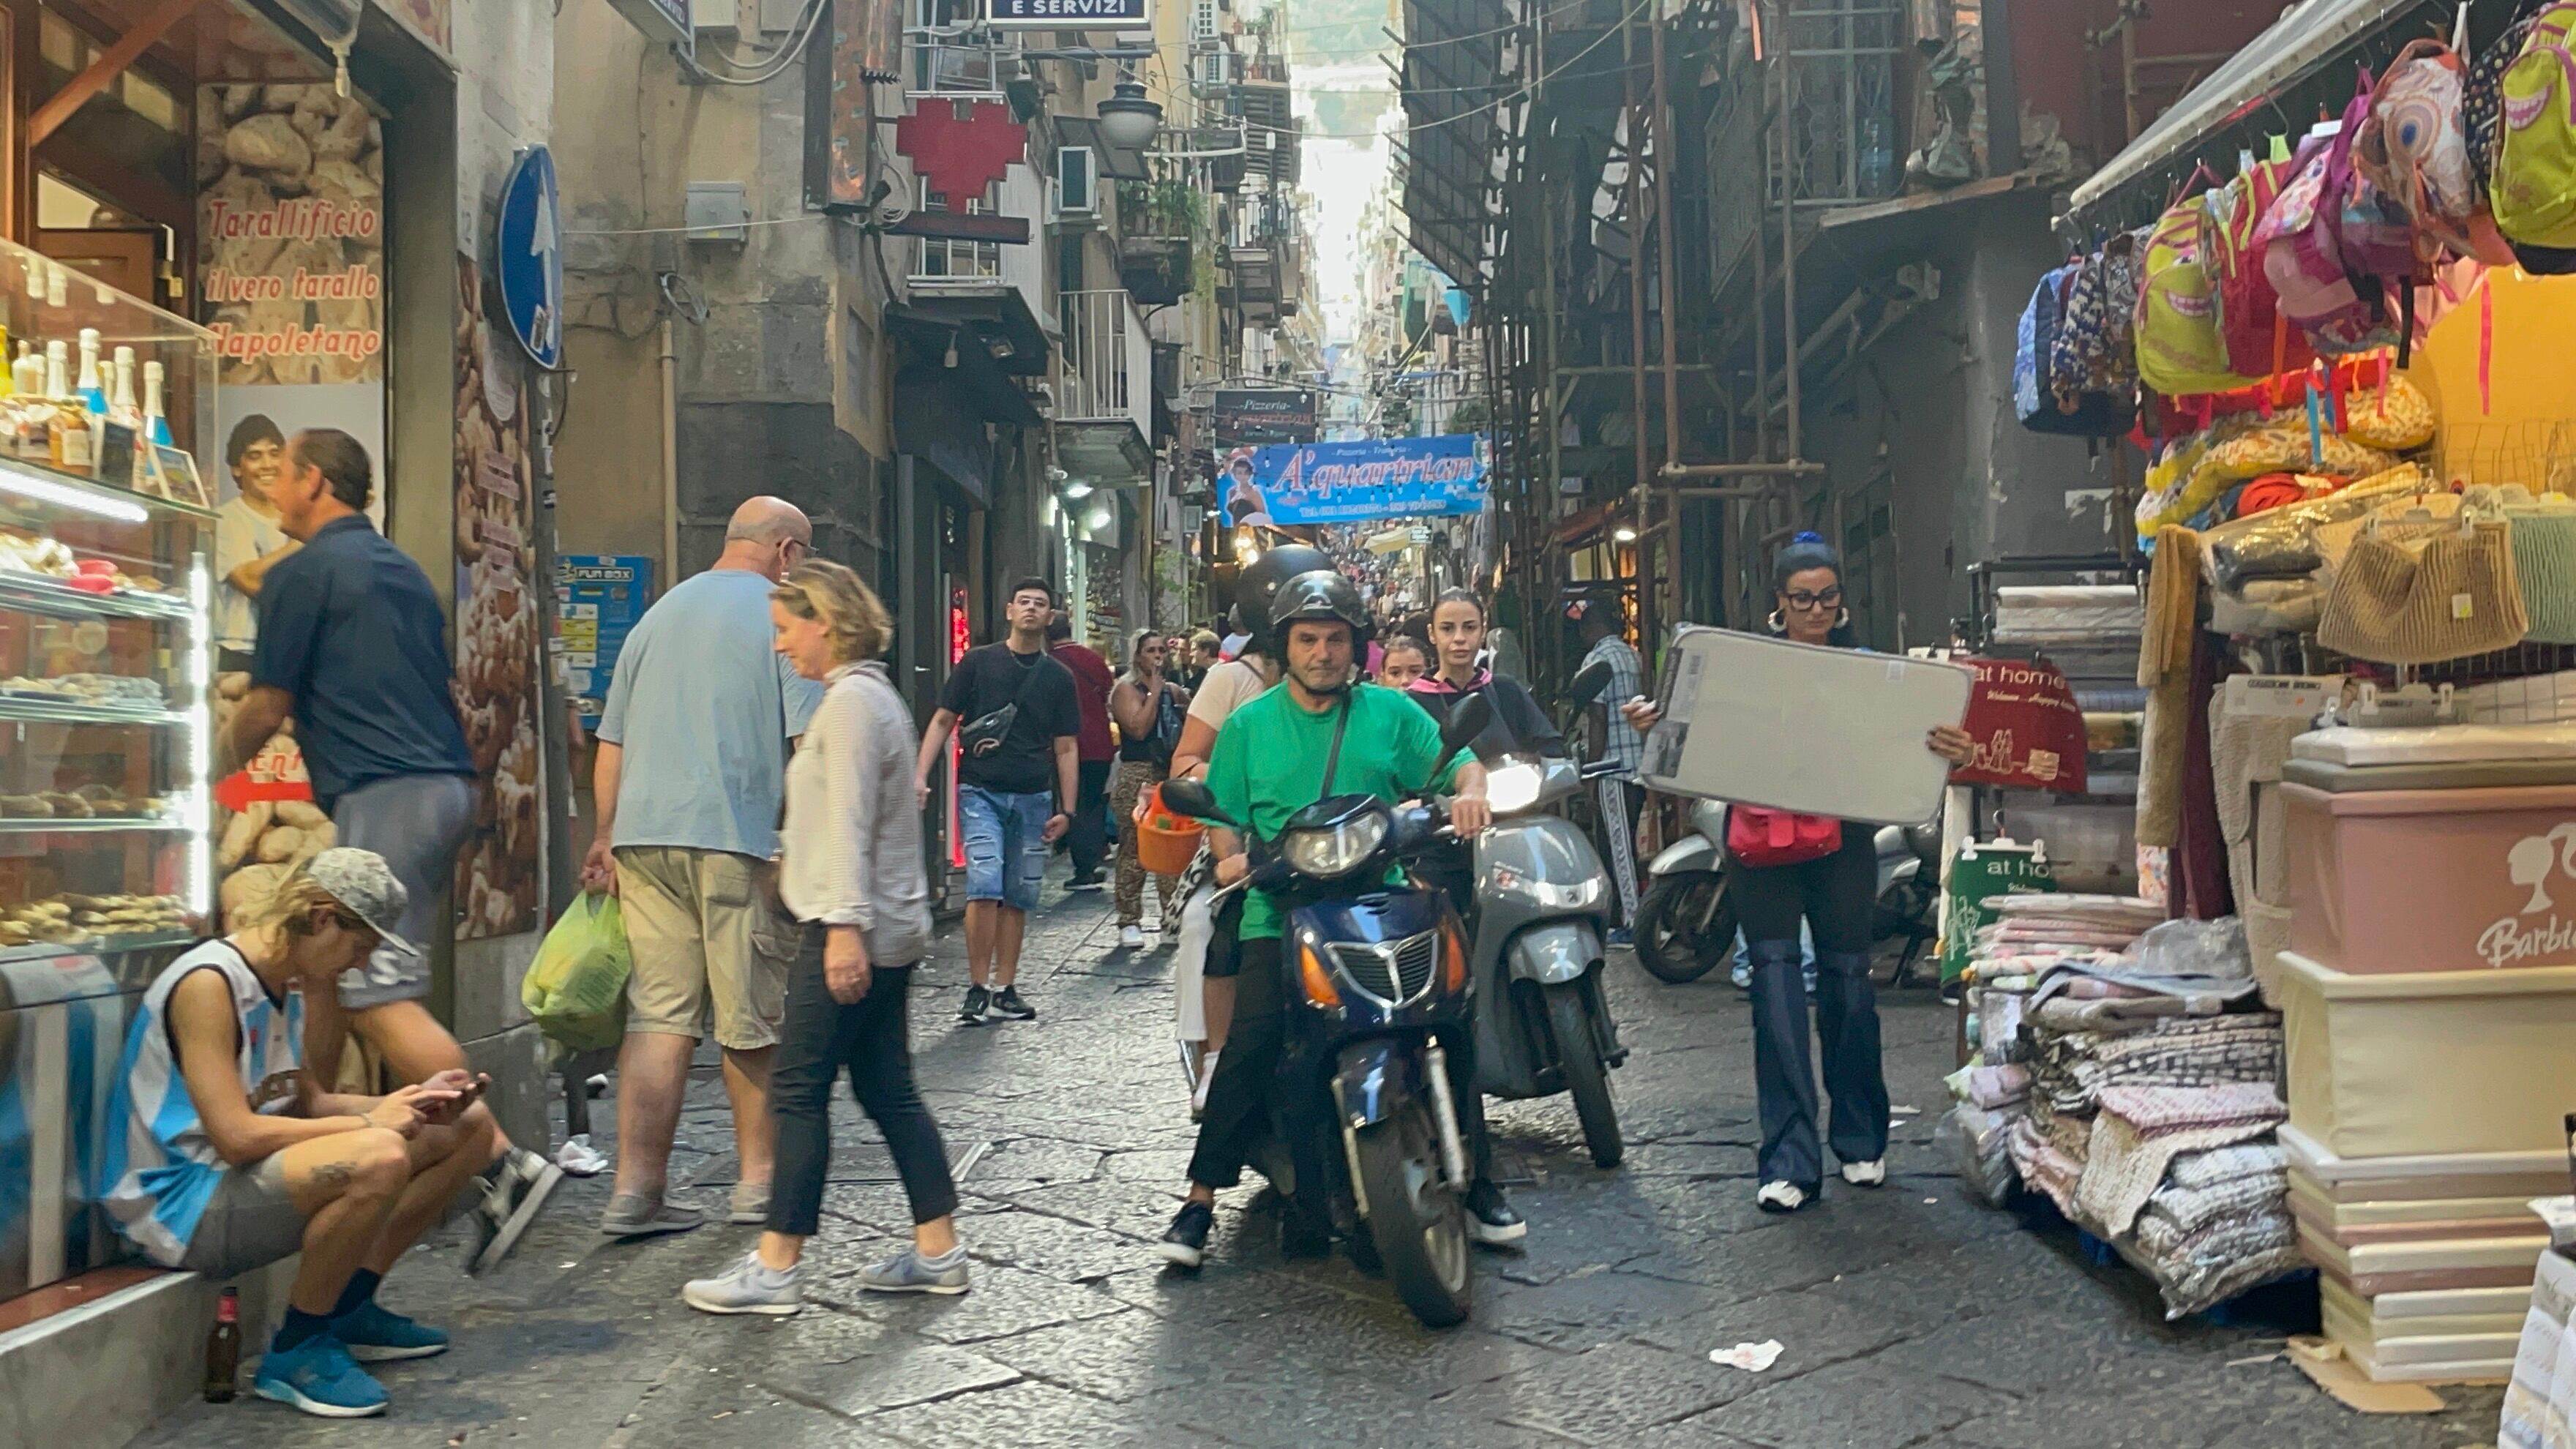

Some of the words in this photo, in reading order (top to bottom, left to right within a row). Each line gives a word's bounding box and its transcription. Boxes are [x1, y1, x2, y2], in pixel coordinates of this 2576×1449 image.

[1012, 0, 1024, 14] E
[1033, 0, 1126, 14] SERVIZI
[212, 200, 375, 244] Tarallificio
[293, 265, 379, 299] tarallo
[209, 323, 381, 364] Napoletano
[1975, 667, 1993, 682] at
[1987, 859, 2011, 875] at
